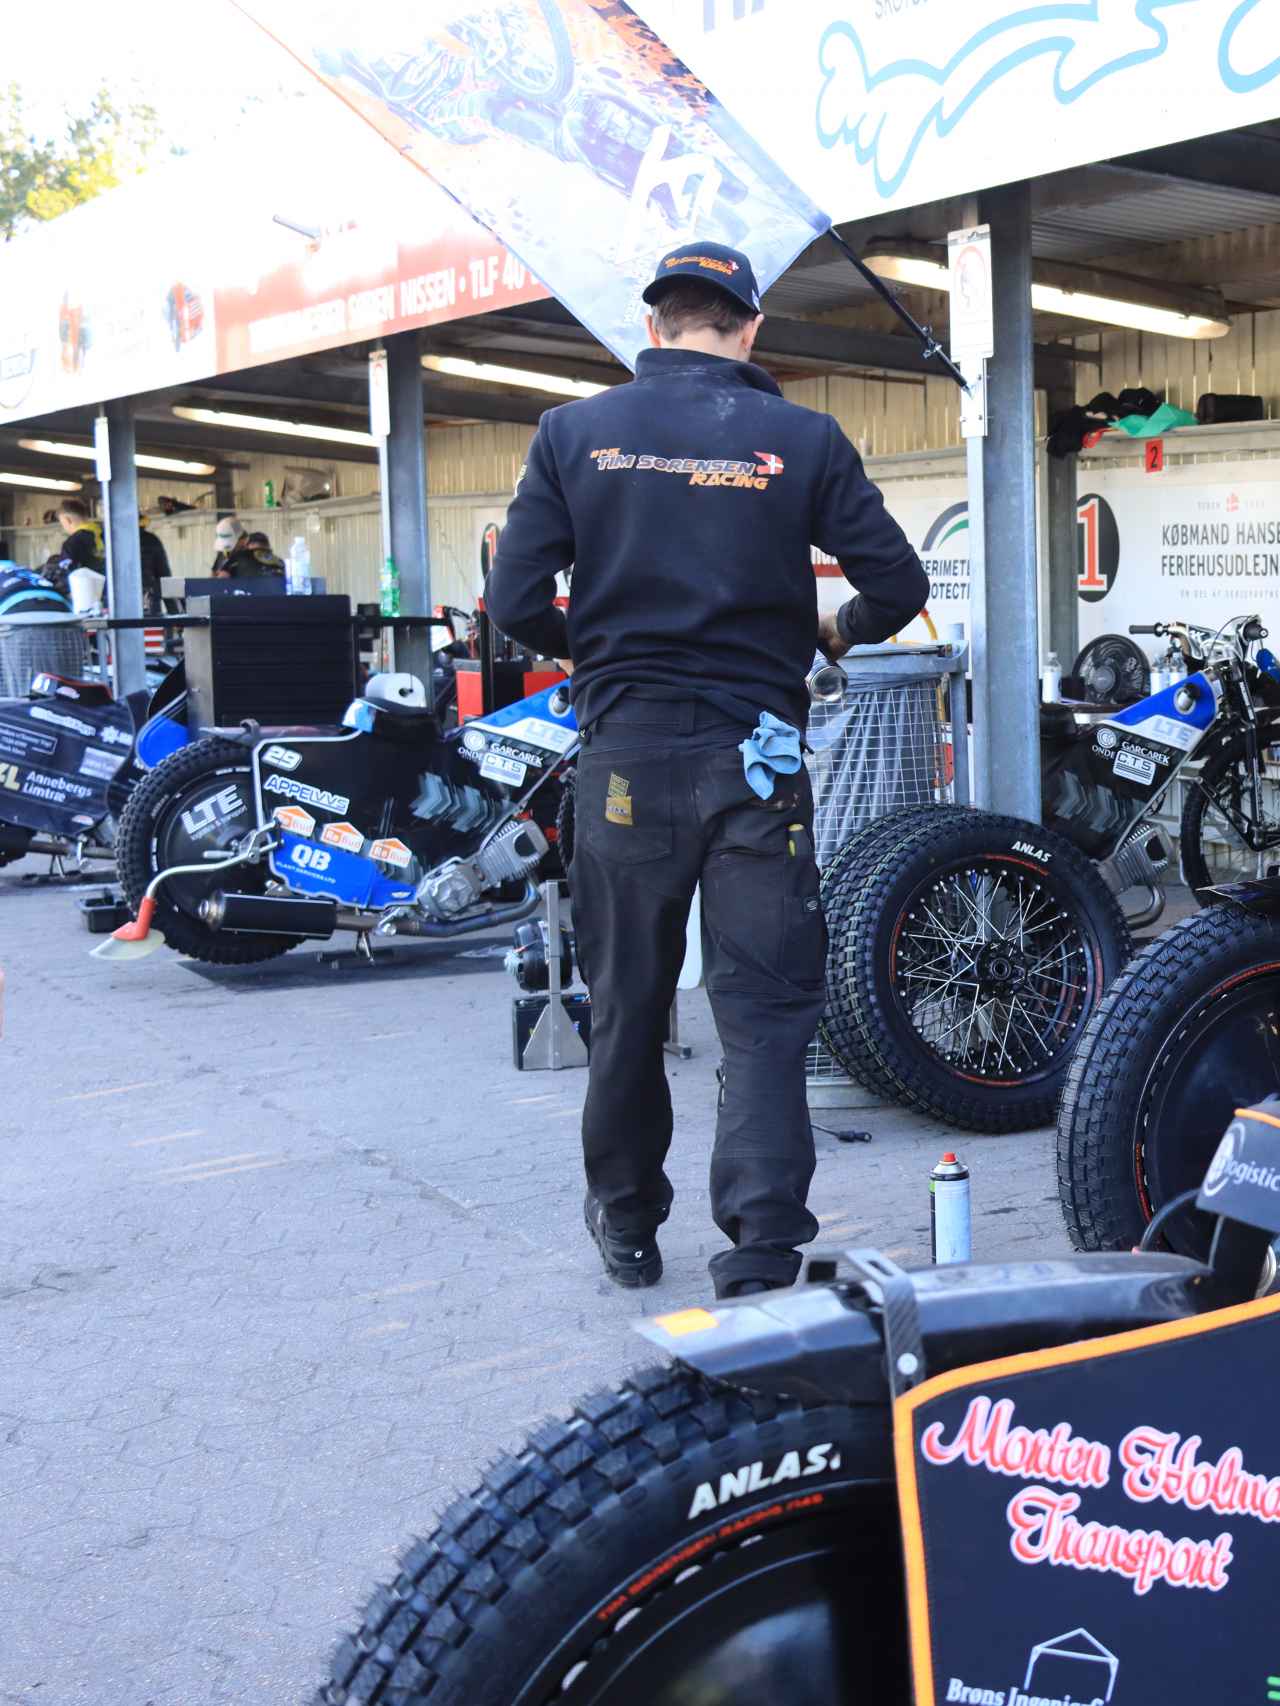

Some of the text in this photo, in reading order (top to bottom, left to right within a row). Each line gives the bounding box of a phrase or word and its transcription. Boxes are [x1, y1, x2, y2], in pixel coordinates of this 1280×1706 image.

[401, 267, 456, 318] NISSEN
[469, 256, 499, 300] TLF
[598, 454, 636, 471] TIM
[1151, 446, 1159, 468] 2
[689, 473, 770, 491] RACING
[1077, 498, 1108, 591] 1
[1162, 522, 1230, 547] KØBMAND
[263, 746, 302, 770] 29
[1121, 740, 1171, 767] GARCAREK
[27, 771, 92, 799] Annebergs
[181, 784, 245, 835] LTE
[291, 844, 332, 871] QB
[1012, 840, 1052, 863] ANLAS
[922, 1396, 1111, 1488] Morten
[1007, 1485, 1233, 1595] Transport
